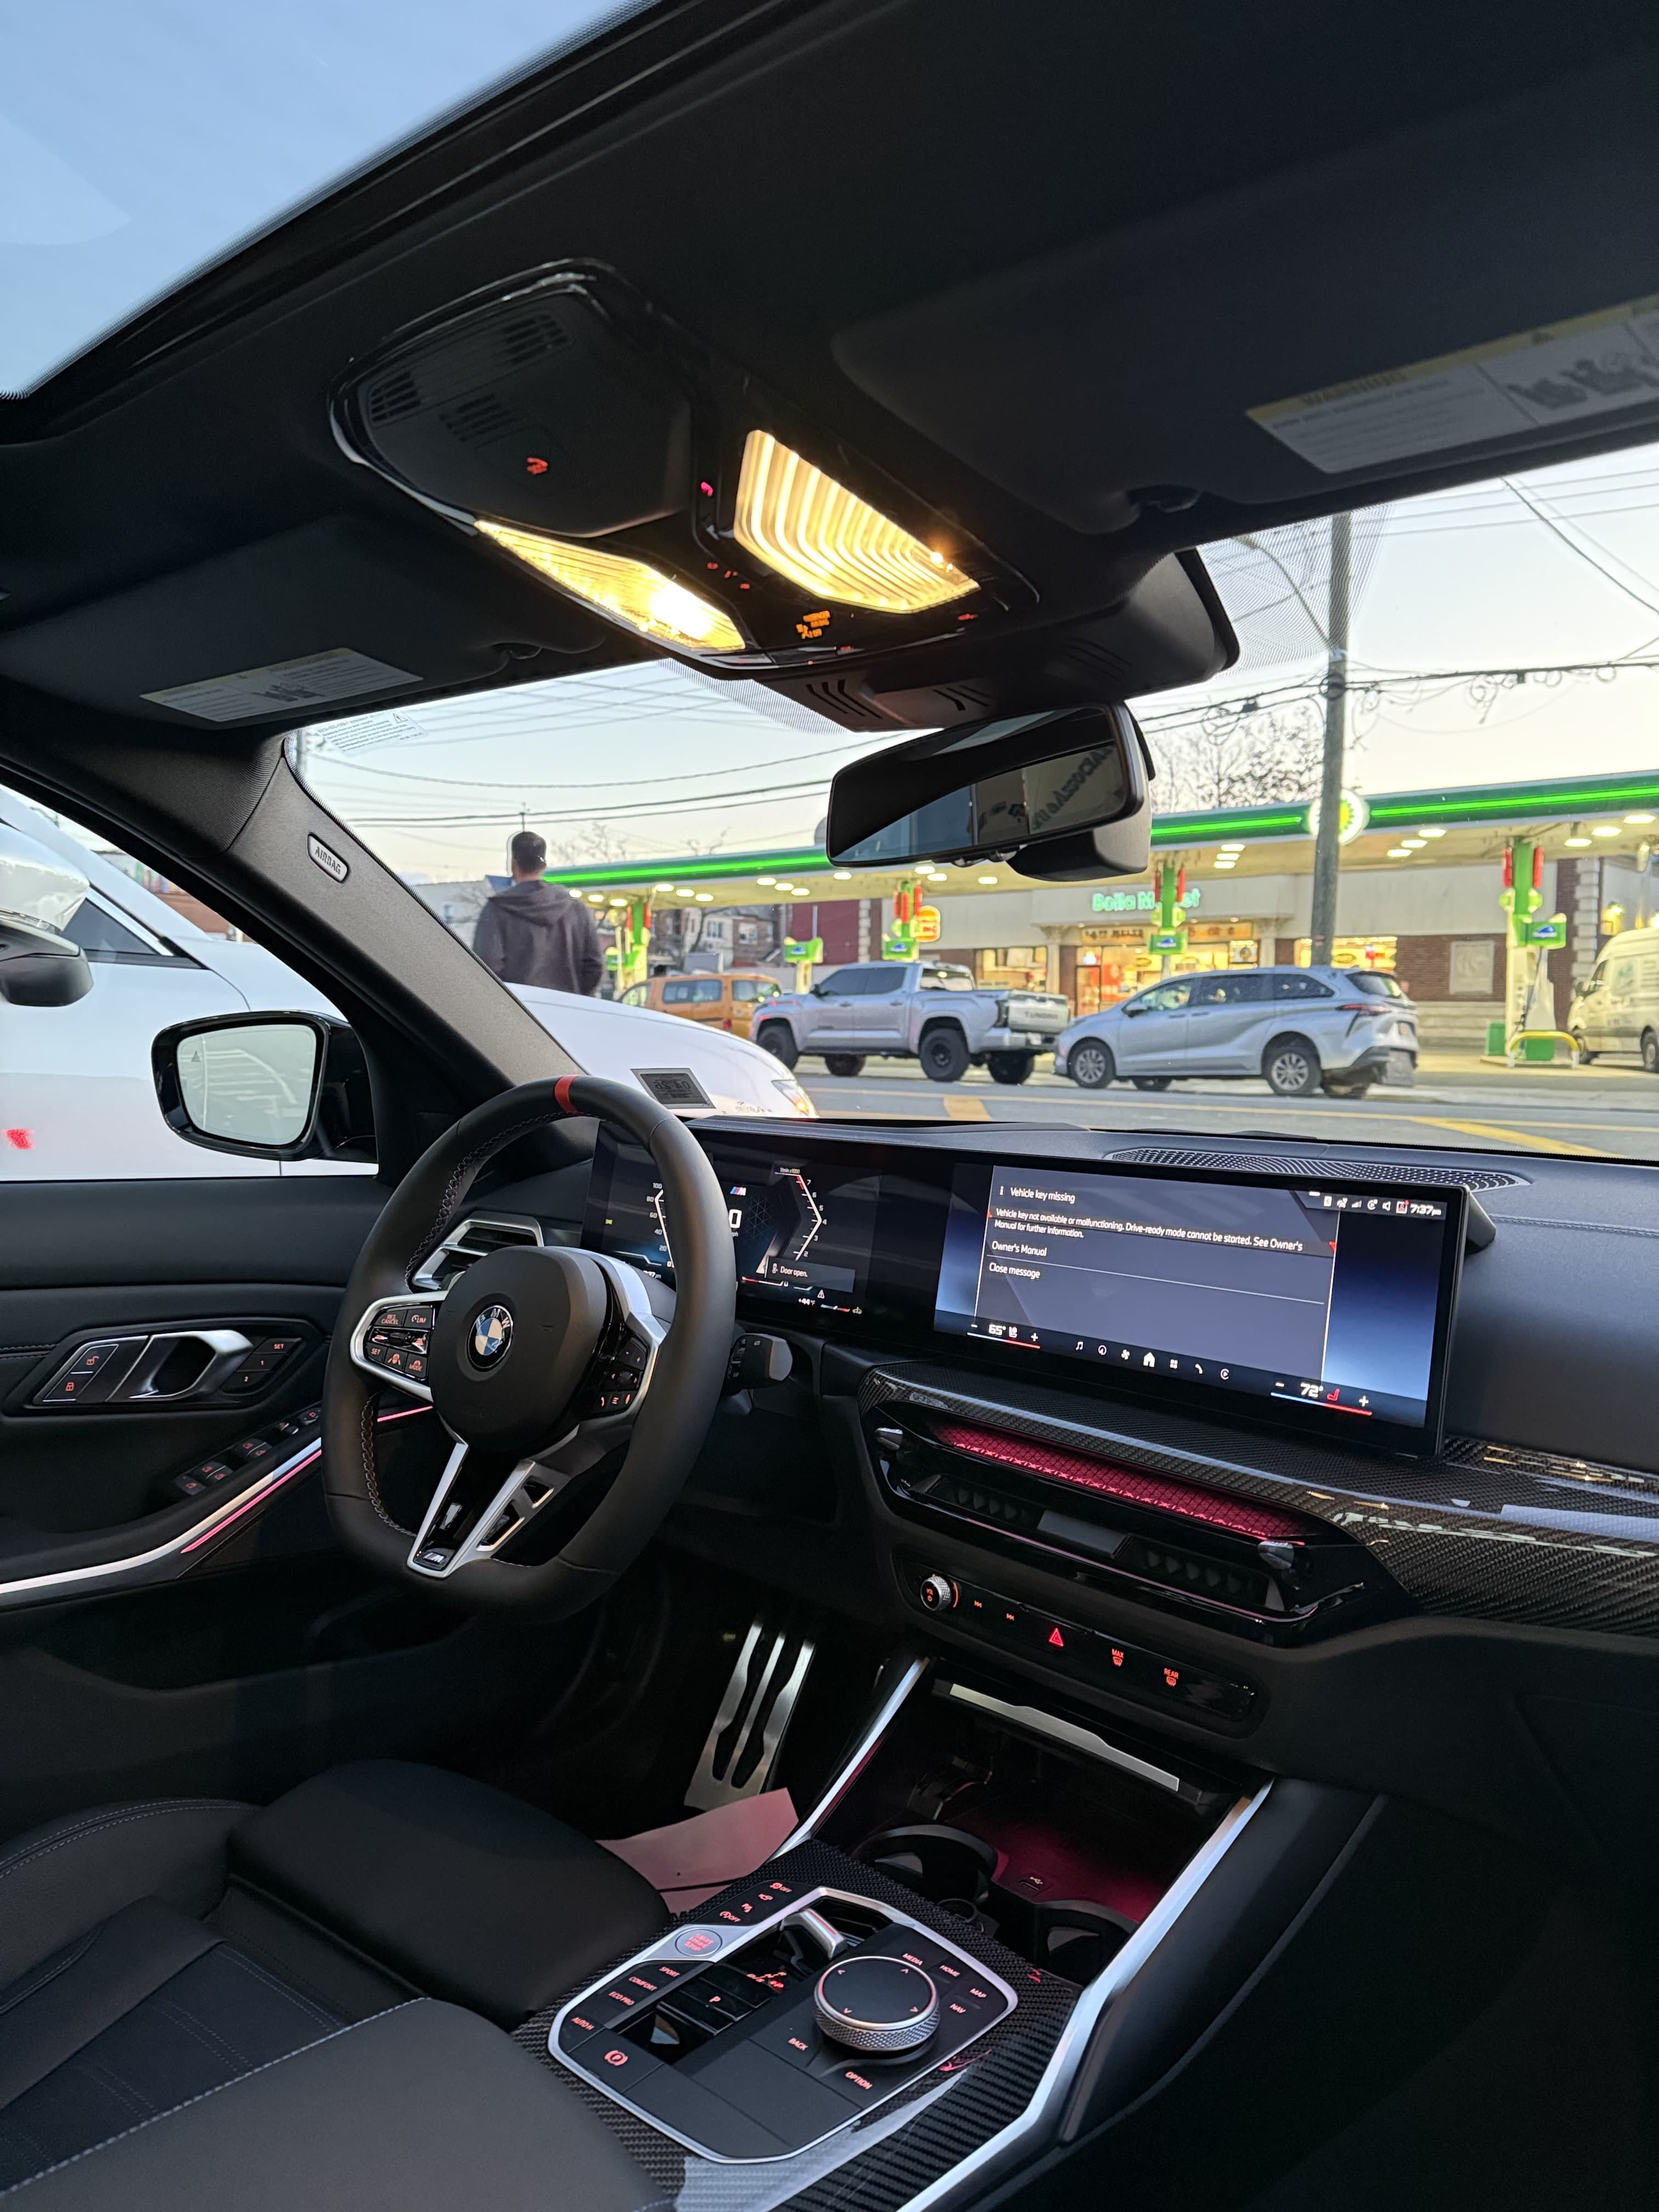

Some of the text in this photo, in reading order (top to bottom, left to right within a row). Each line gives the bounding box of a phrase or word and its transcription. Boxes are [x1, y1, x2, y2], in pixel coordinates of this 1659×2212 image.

[315, 847, 341, 874] AIRBAG
[1092, 888, 1201, 912] Bolla Met
[1010, 1187, 1075, 1204] Vehicle key missing
[729, 1209, 742, 1228] 0
[994, 1220, 1084, 1238] Manual for further information.
[996, 1208, 1017, 1218] Vehicle
[1018, 1211, 1029, 1220] key
[1040, 1214, 1067, 1224] available
[1076, 1218, 1125, 1232] malfunctioning.
[1125, 1222, 1165, 1236] Drive-ready
[1165, 1228, 1186, 1238] mode
[1187, 1231, 1212, 1241] cannot
[1213, 1232, 1223, 1242] be
[1223, 1234, 1252, 1245] started.
[1253, 1237, 1268, 1248] See
[1269, 1238, 1303, 1251] Owner's
[991, 1241, 1047, 1257] Owner's Manual
[780, 1266, 808, 1278] Door open.
[989, 1262, 1041, 1280] Close message
[477, 1308, 511, 1329] BMW
[988, 1324, 1006, 1336] 65°
[1111, 1648, 1124, 1658] MAX
[1164, 1668, 1179, 1679] REAR
[902, 1953, 923, 1966] MEDIA
[659, 1966, 680, 1977] SPORT
[939, 1965, 961, 1977] HOME
[628, 1976, 658, 1991] COMFORT
[608, 1991, 635, 2006] ECO PRO
[969, 1988, 987, 1999] MAP
[950, 2003, 966, 2014] NAV
[571, 2017, 588, 2029] AUTO
[788, 2038, 808, 2051] BACK
[845, 2071, 872, 2090] OPTION
